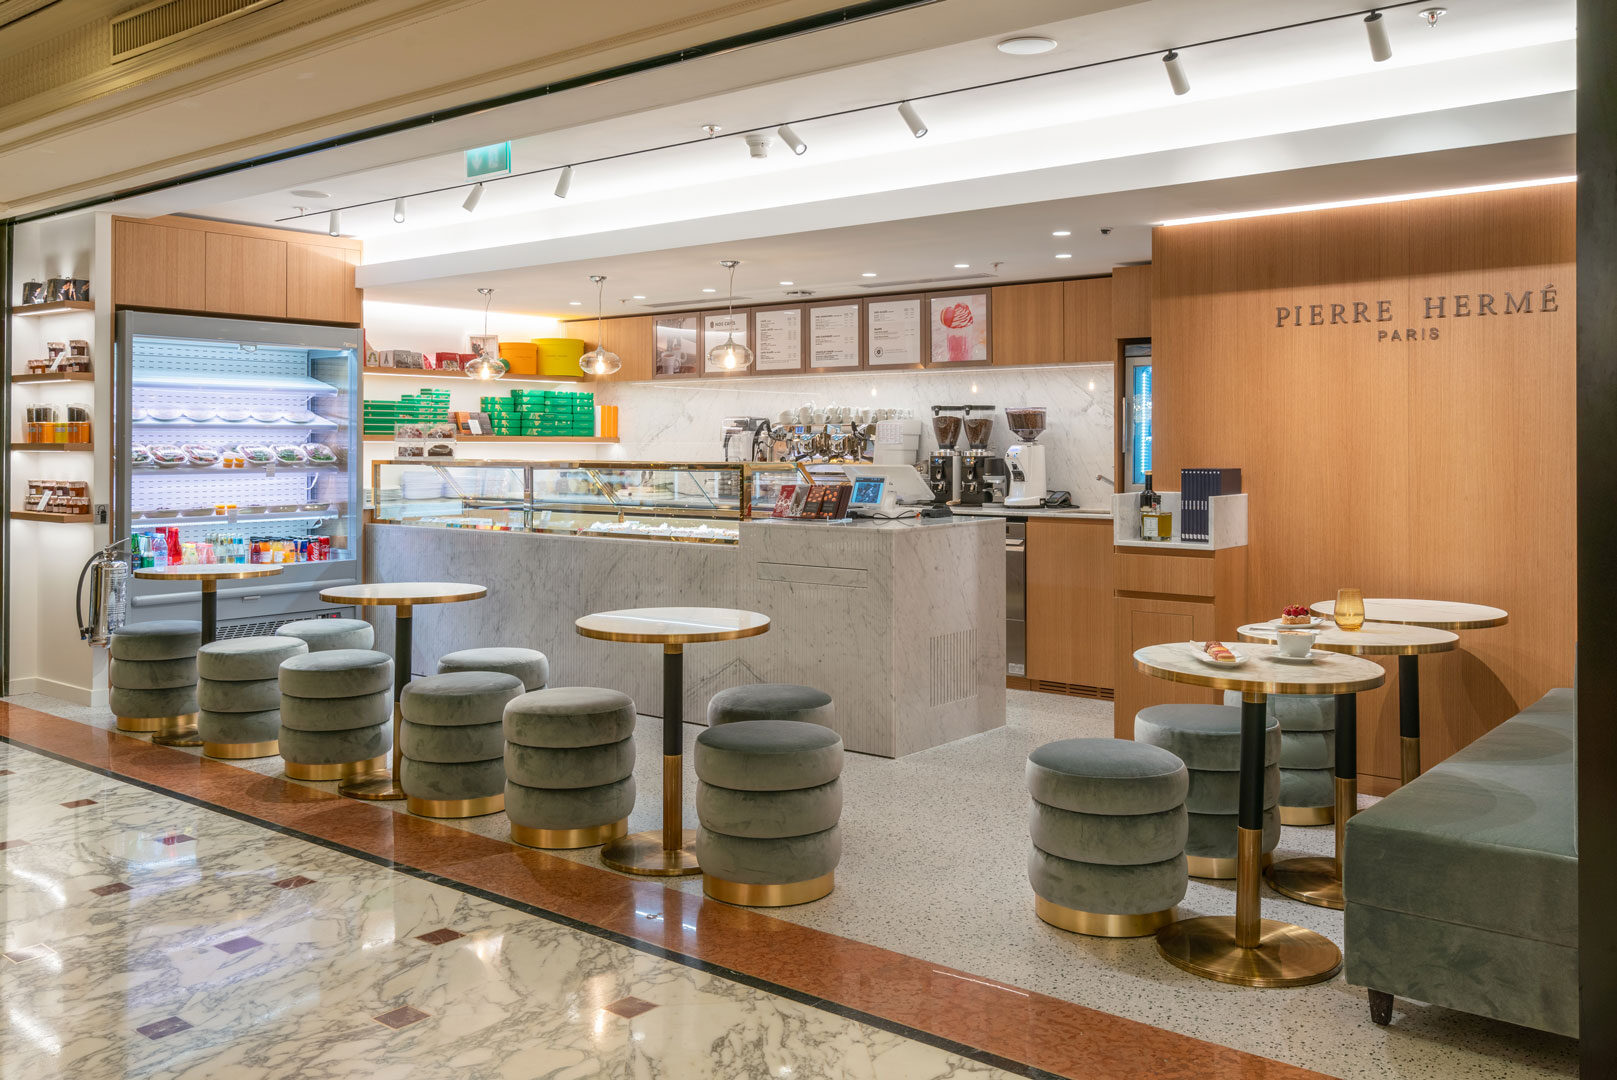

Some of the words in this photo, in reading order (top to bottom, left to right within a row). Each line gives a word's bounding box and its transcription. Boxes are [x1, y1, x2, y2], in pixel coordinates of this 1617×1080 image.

[1276, 300, 1393, 328] PIERRE
[1424, 284, 1558, 319] HERMÉ
[1378, 327, 1440, 342] PARIS
